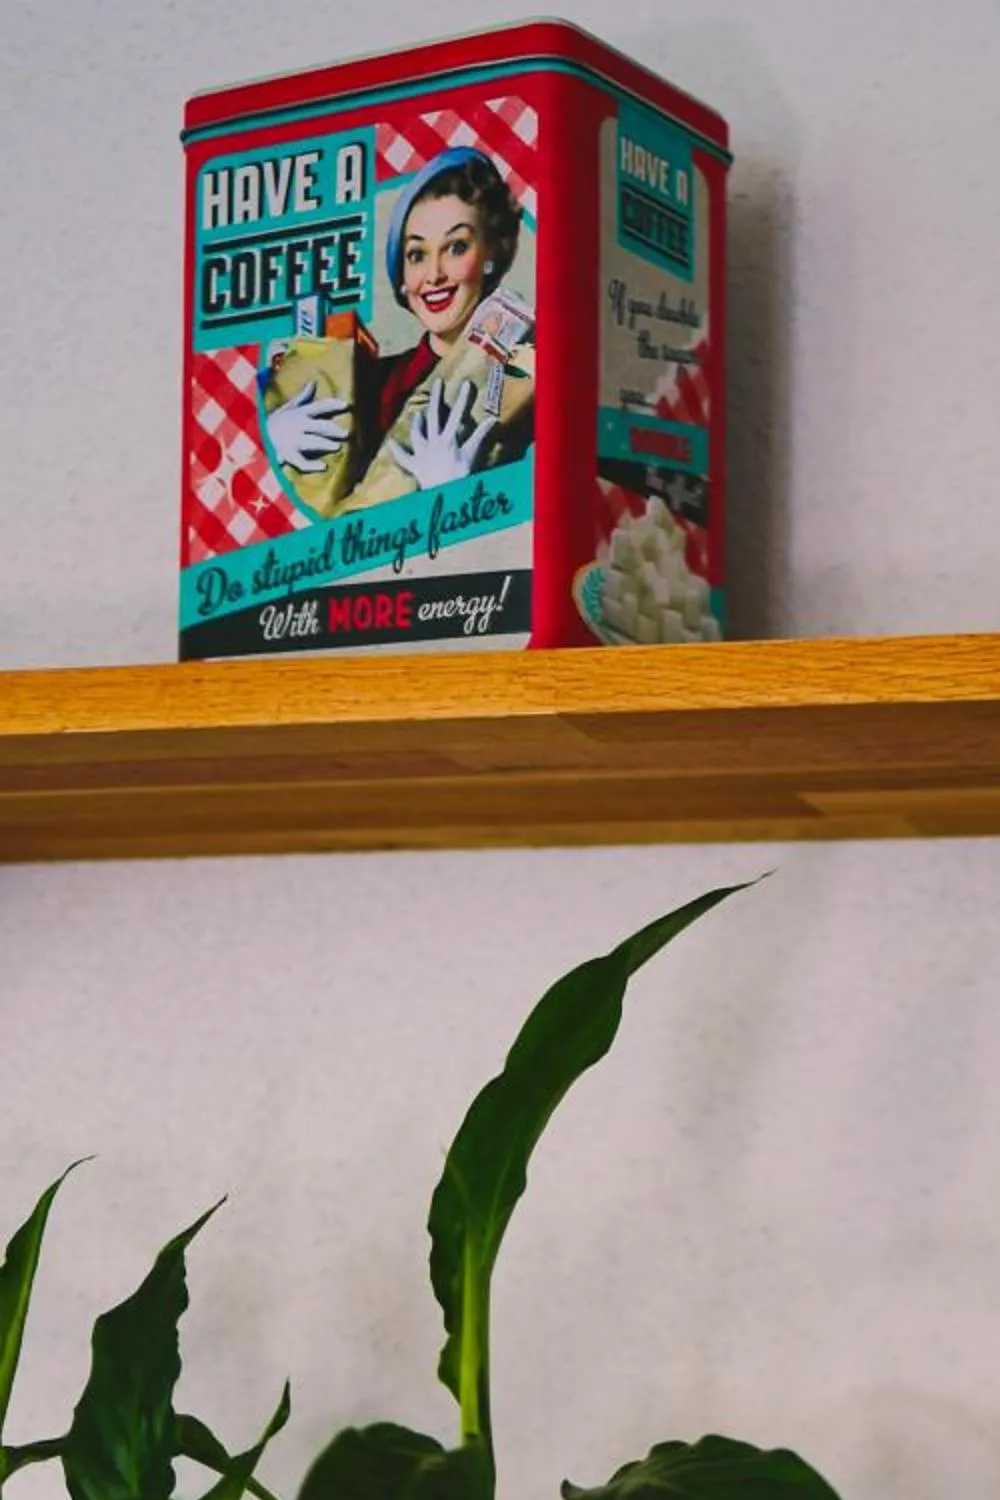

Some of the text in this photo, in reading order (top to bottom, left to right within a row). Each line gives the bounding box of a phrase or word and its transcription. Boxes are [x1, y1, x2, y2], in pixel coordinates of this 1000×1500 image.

[202, 143, 366, 230] HAVE A
[620, 136, 690, 205] HAVE A
[203, 230, 366, 314] COFFEE
[196, 480, 515, 617] Do stupid things faster
[259, 575, 513, 641] With MORE energy!
